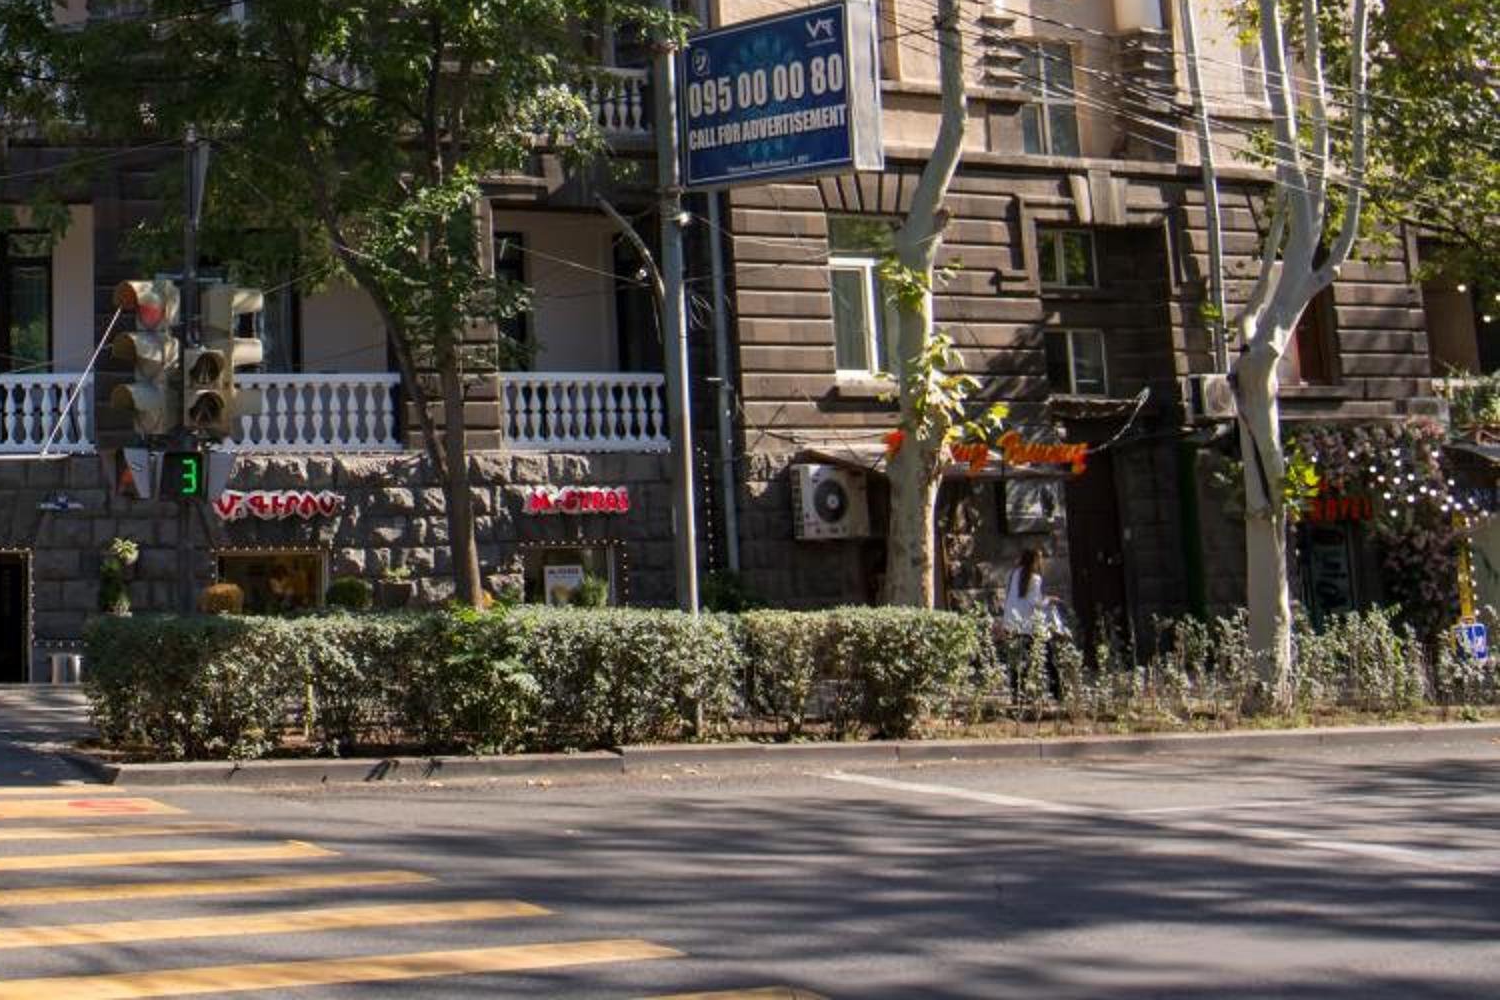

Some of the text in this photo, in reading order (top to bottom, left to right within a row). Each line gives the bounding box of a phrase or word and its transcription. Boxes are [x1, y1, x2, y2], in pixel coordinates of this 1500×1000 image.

[689, 53, 844, 118] 095 00 00 80
[689, 103, 848, 150] CALL FOR ADVERTISEMENT
[182, 459, 197, 493] 3
